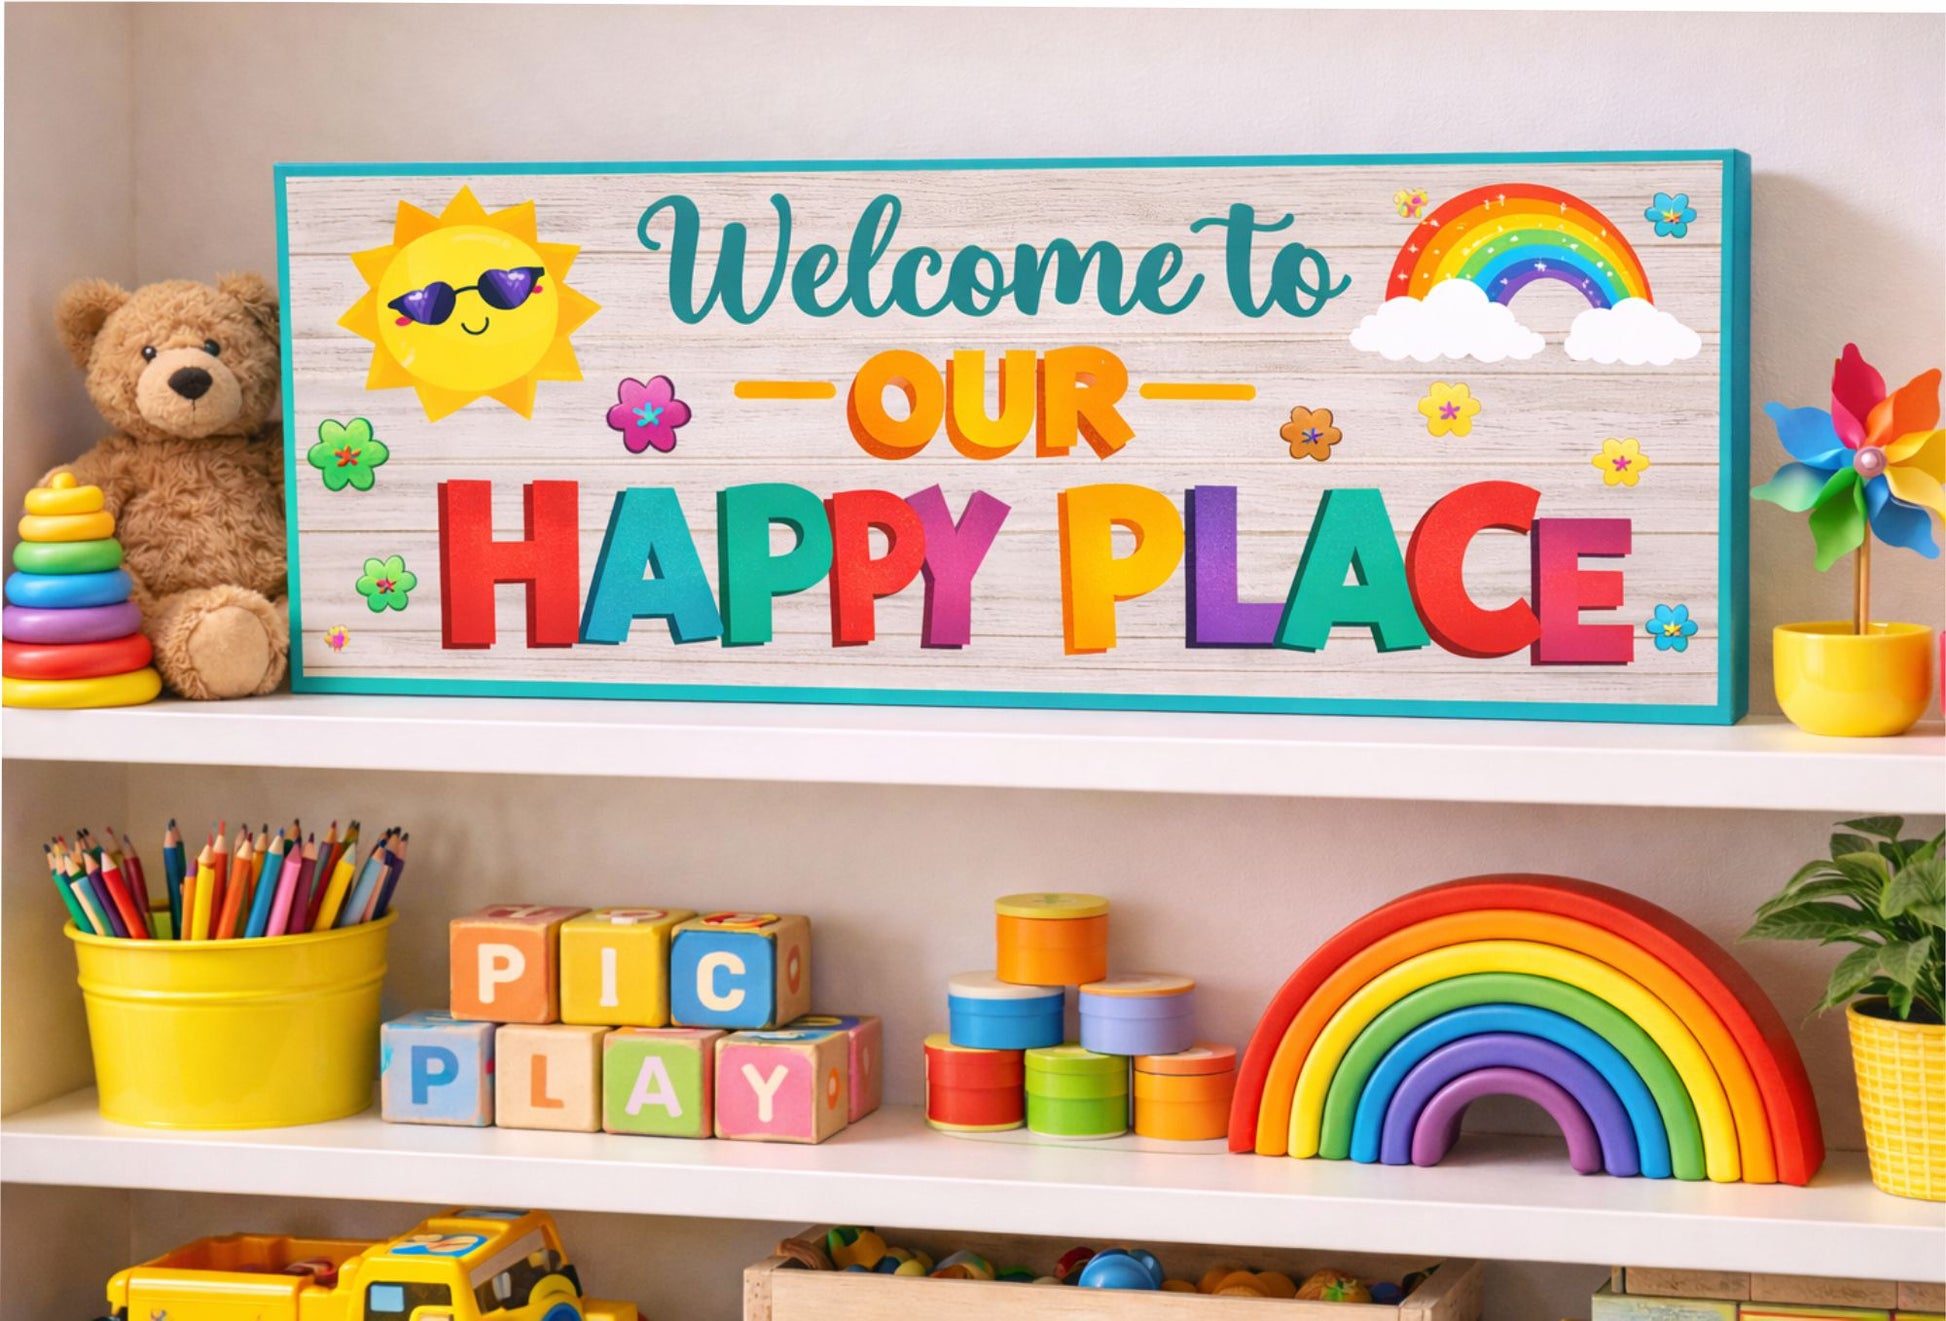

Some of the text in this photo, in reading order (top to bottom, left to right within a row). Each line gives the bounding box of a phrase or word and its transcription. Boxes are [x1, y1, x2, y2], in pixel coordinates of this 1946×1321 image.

[637, 193, 1351, 325] Welcome to
[846, 345, 1136, 461] OUR
[438, 479, 1634, 666] HAPPY PLACE
[477, 943, 746, 1012] PIC
[411, 1045, 789, 1122] PLAY
